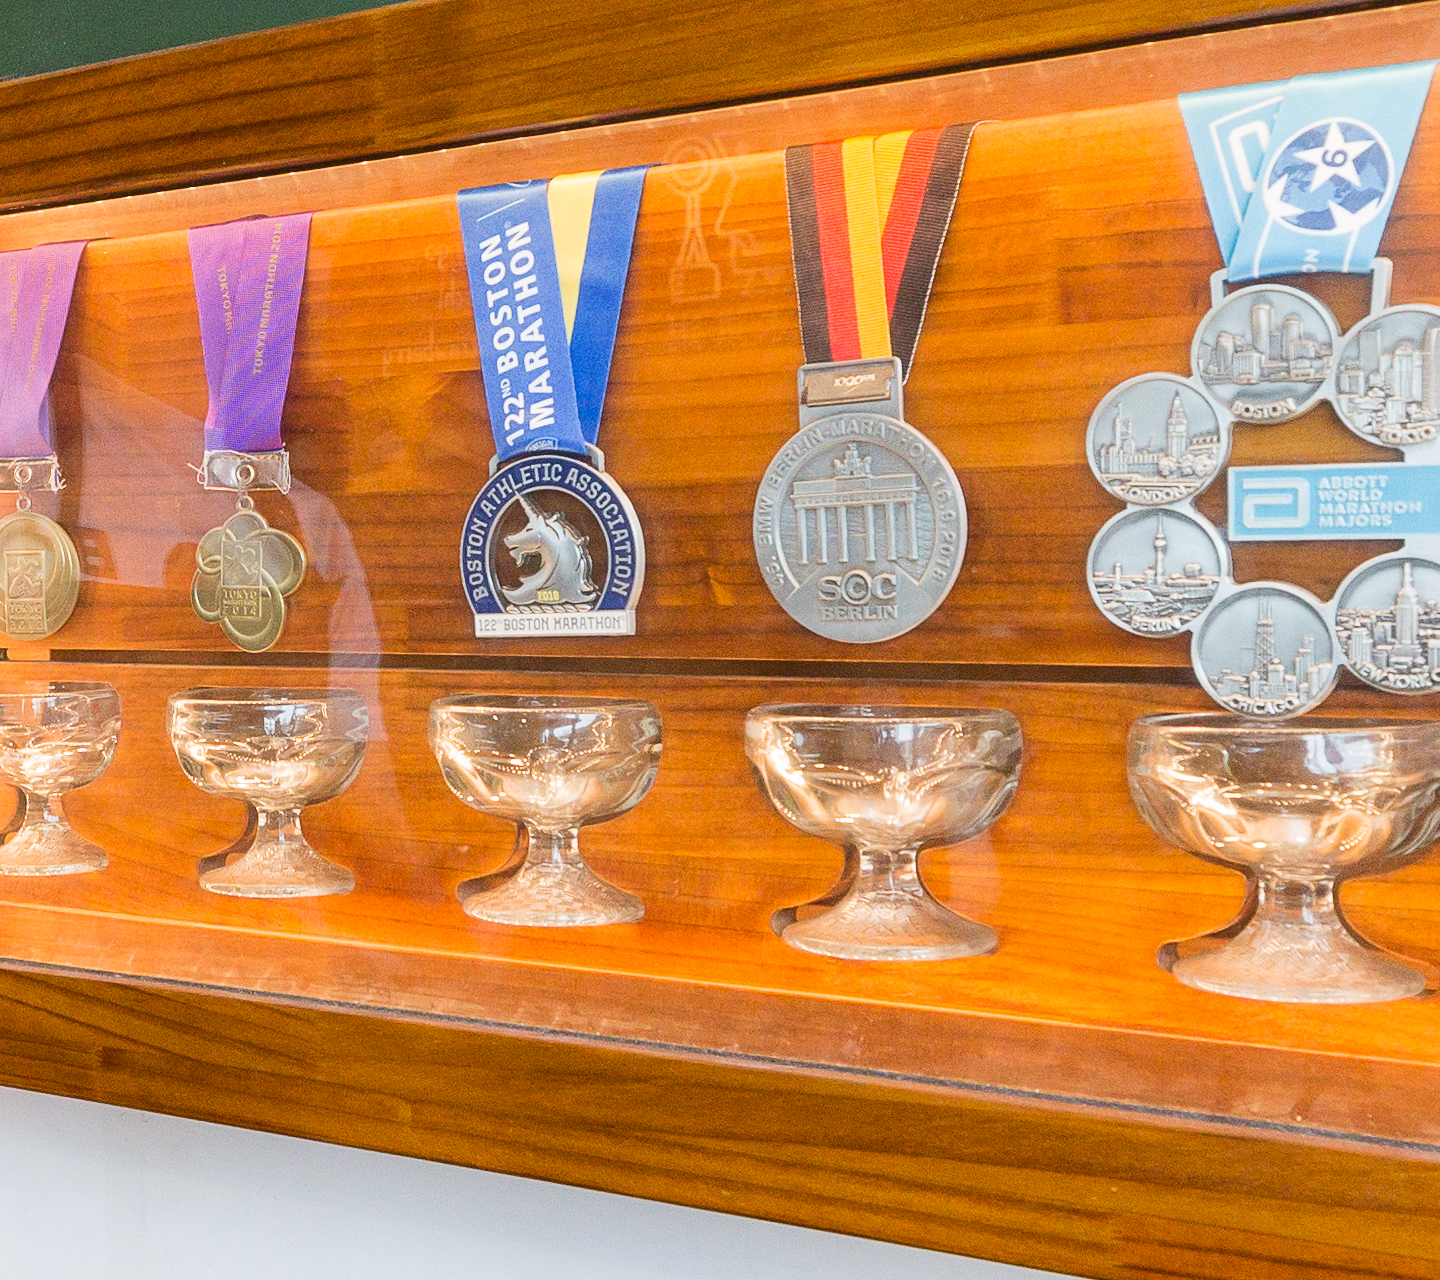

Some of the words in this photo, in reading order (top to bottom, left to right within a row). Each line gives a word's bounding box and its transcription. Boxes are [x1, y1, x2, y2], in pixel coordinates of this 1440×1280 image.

[479, 233, 519, 375] BOSTON
[505, 221, 556, 431] MARATHON
[1231, 398, 1296, 420] BOSTON
[1383, 425, 1435, 443] TOKYO
[1318, 475, 1389, 489] ABBOTT
[1122, 484, 1187, 503] LONDON
[1318, 489, 1384, 502] WORLD
[1318, 501, 1422, 515] MARATHON
[757, 494, 774, 547] BMW
[1318, 514, 1393, 528] MAJORS
[468, 517, 489, 602] BOSTON
[480, 462, 562, 518] ATHLETIC
[564, 468, 632, 598] ASSOCIATION
[222, 589, 258, 600] TOKYO
[819, 605, 899, 621] BERLIN
[504, 617, 550, 631] BOSTON
[553, 616, 622, 630] MARATHON
[1130, 614, 1181, 633] BERLIN
[1381, 672, 1433, 689] YORK
[1227, 696, 1300, 715] CHICAGO
